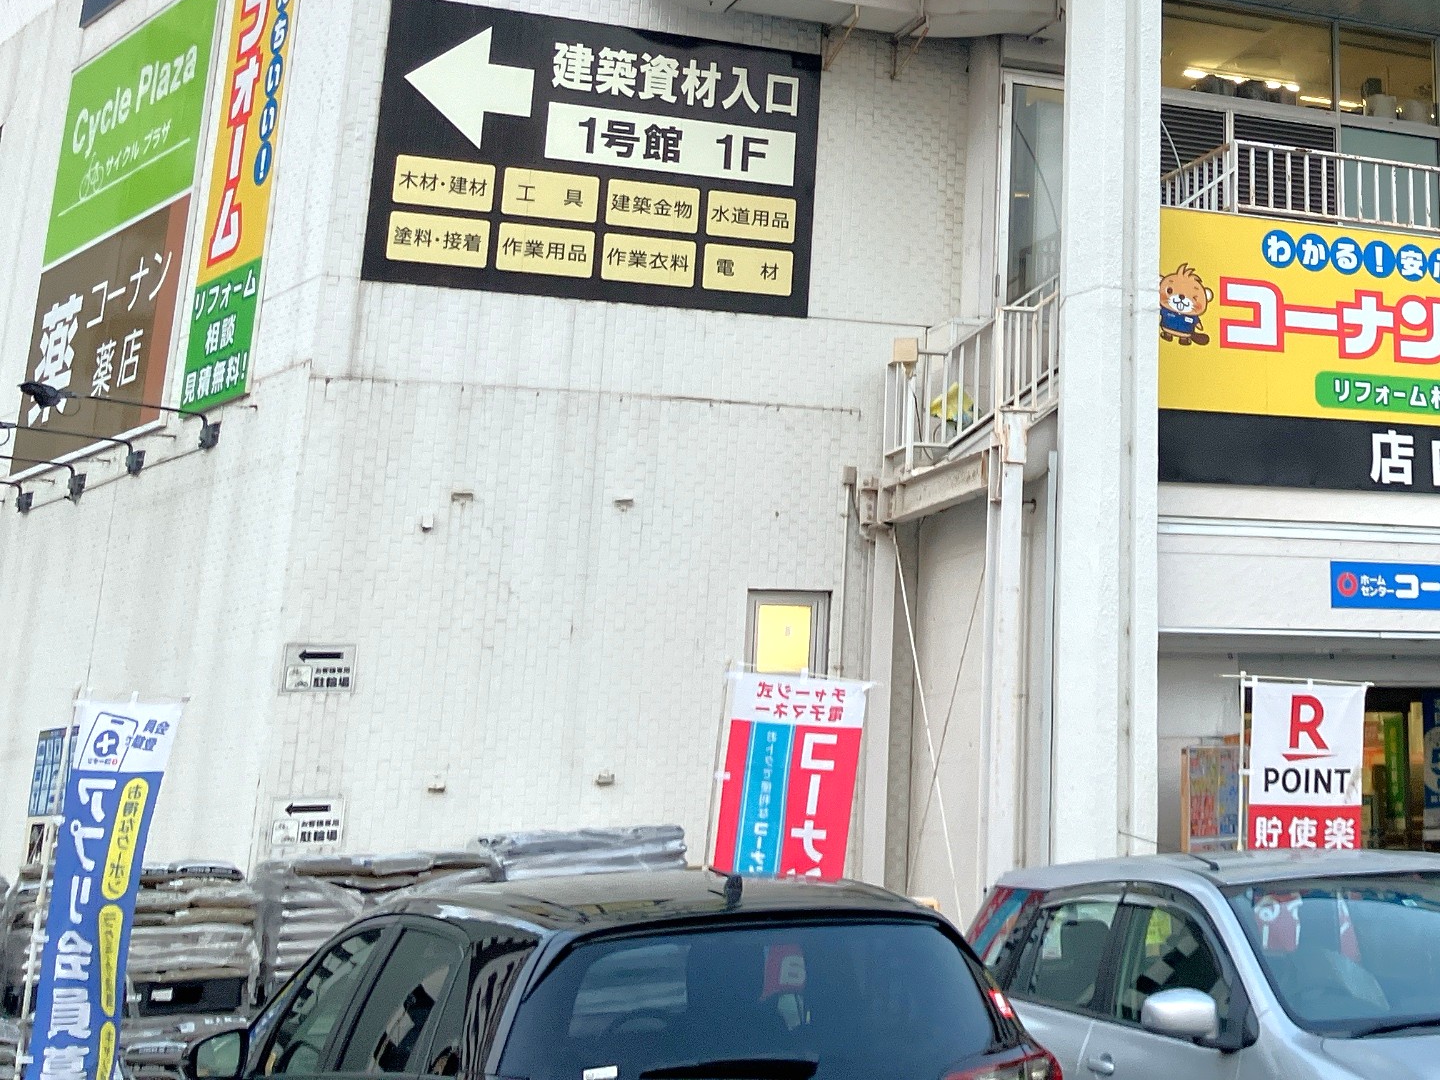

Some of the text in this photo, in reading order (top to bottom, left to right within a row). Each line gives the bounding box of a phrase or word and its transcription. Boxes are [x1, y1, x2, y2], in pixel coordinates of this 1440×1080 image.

[552, 42, 799, 117] 建築資材入口
[73, 43, 196, 157] Cycle Plaza
[579, 116, 770, 172] 1号館 1F
[399, 171, 488, 198] 木材・建材
[611, 193, 693, 220] 建築金物
[711, 207, 790, 230] 水道用品
[394, 225, 482, 253] 塗料・接着
[502, 237, 588, 263] 作業用品
[606, 248, 689, 272] 作業衣料
[87, 252, 173, 329] コーナン
[194, 270, 257, 314] リフォーム
[205, 313, 236, 353] 相談
[91, 328, 142, 397] 薬店
[1360, 585, 1395, 598] センター
[1361, 574, 1387, 586] ホーム
[1289, 695, 1329, 750] R
[1264, 768, 1351, 794] POINT
